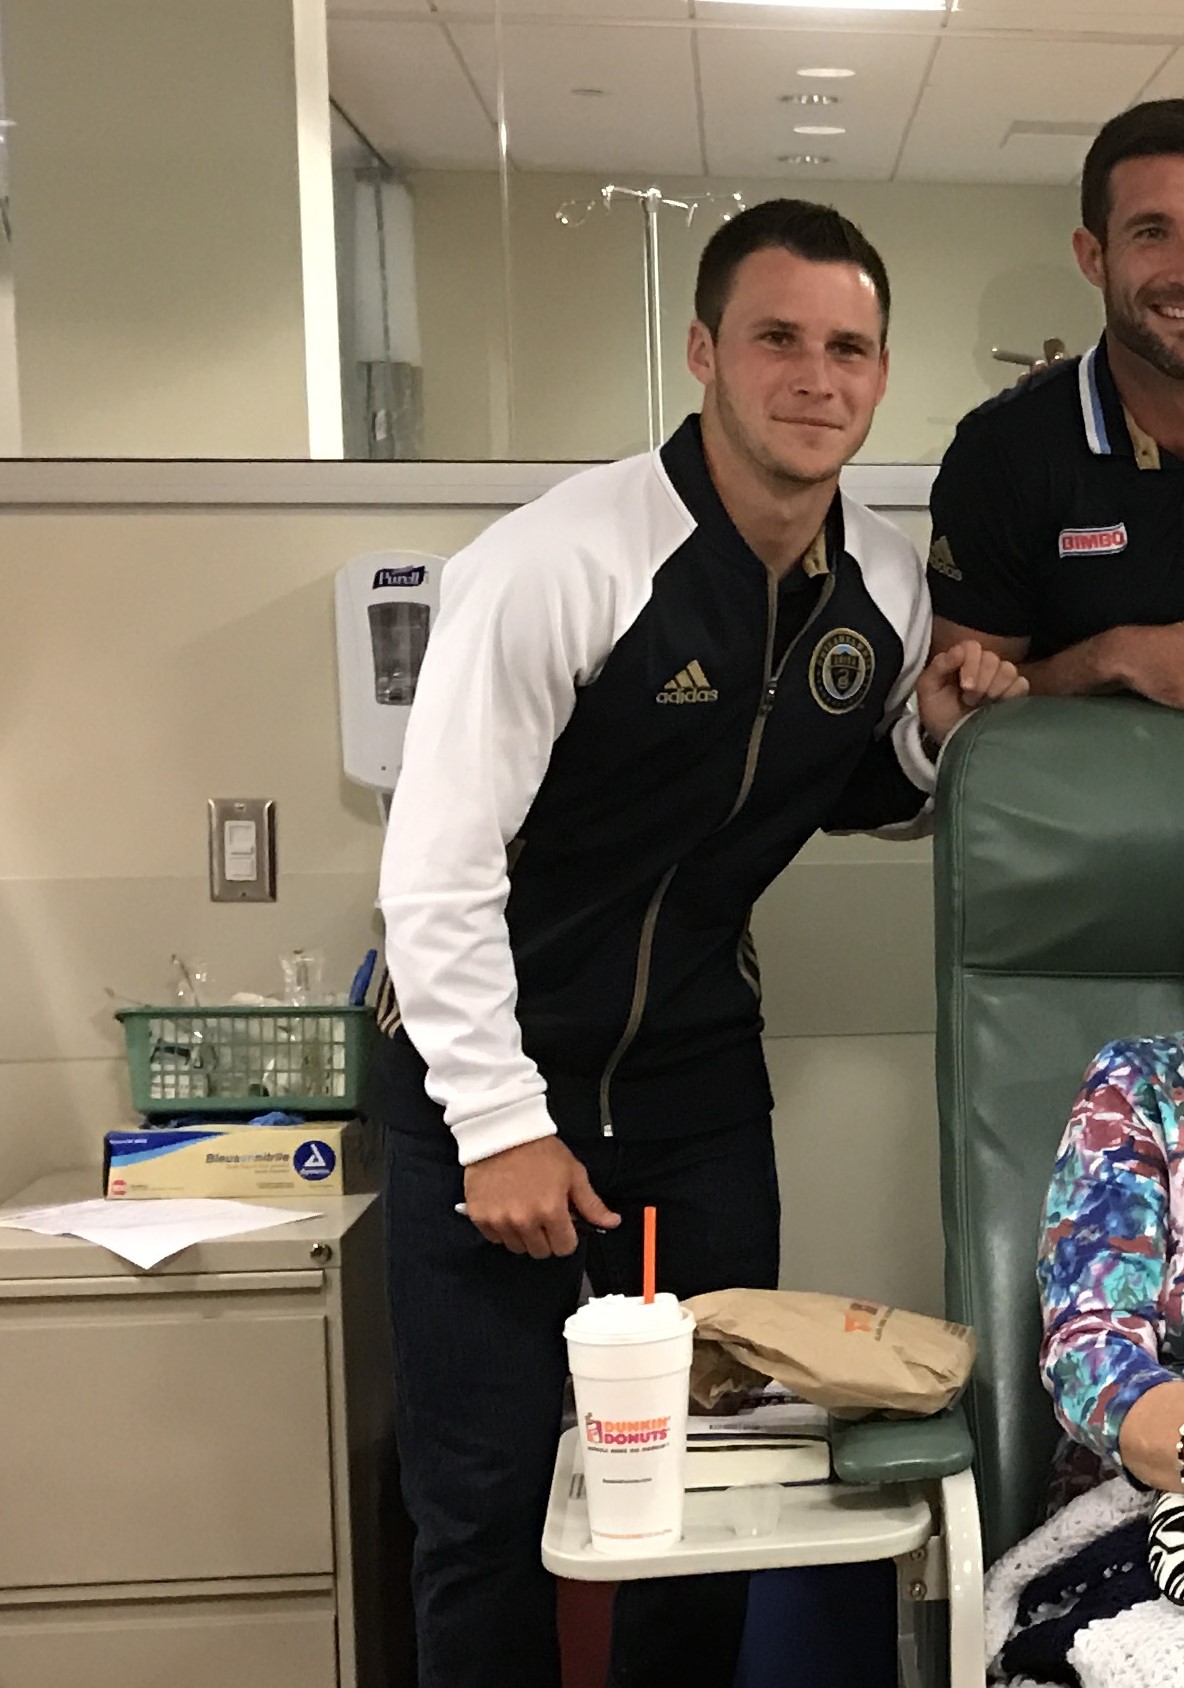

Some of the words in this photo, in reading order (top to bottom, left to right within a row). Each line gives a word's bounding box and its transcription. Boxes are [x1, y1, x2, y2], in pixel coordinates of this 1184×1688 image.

[1062, 530, 1125, 551] BIMBO
[655, 688, 719, 704] adidas
[604, 1430, 668, 1445] DONUTS
